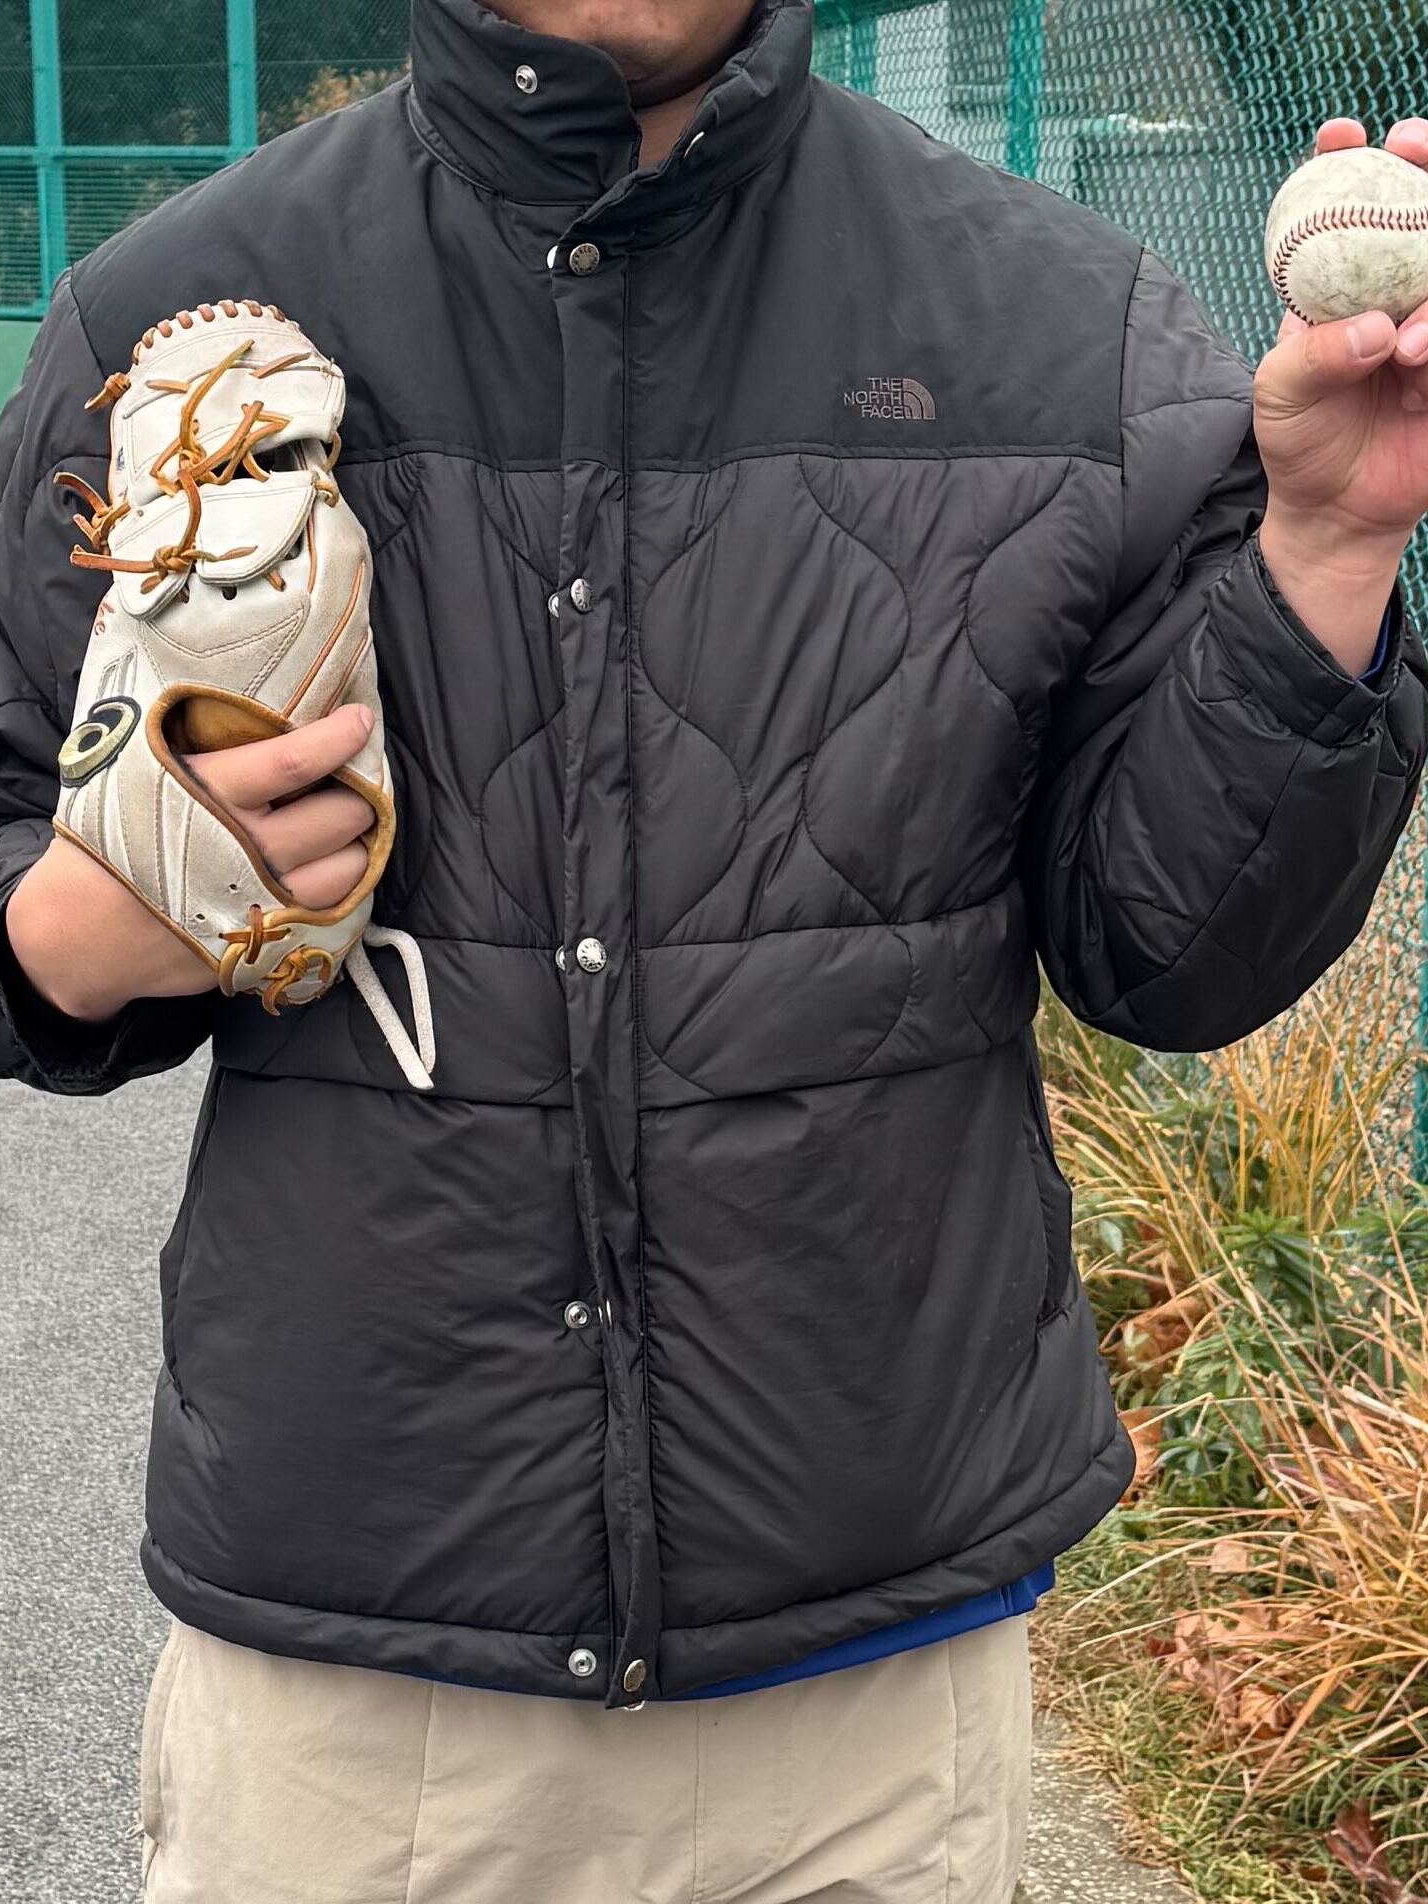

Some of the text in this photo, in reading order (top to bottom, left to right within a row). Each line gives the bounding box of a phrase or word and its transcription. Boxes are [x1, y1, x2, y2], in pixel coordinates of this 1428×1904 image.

[867, 377, 903, 391] THE
[843, 390, 903, 405] NORTH
[861, 404, 905, 420] FACE
